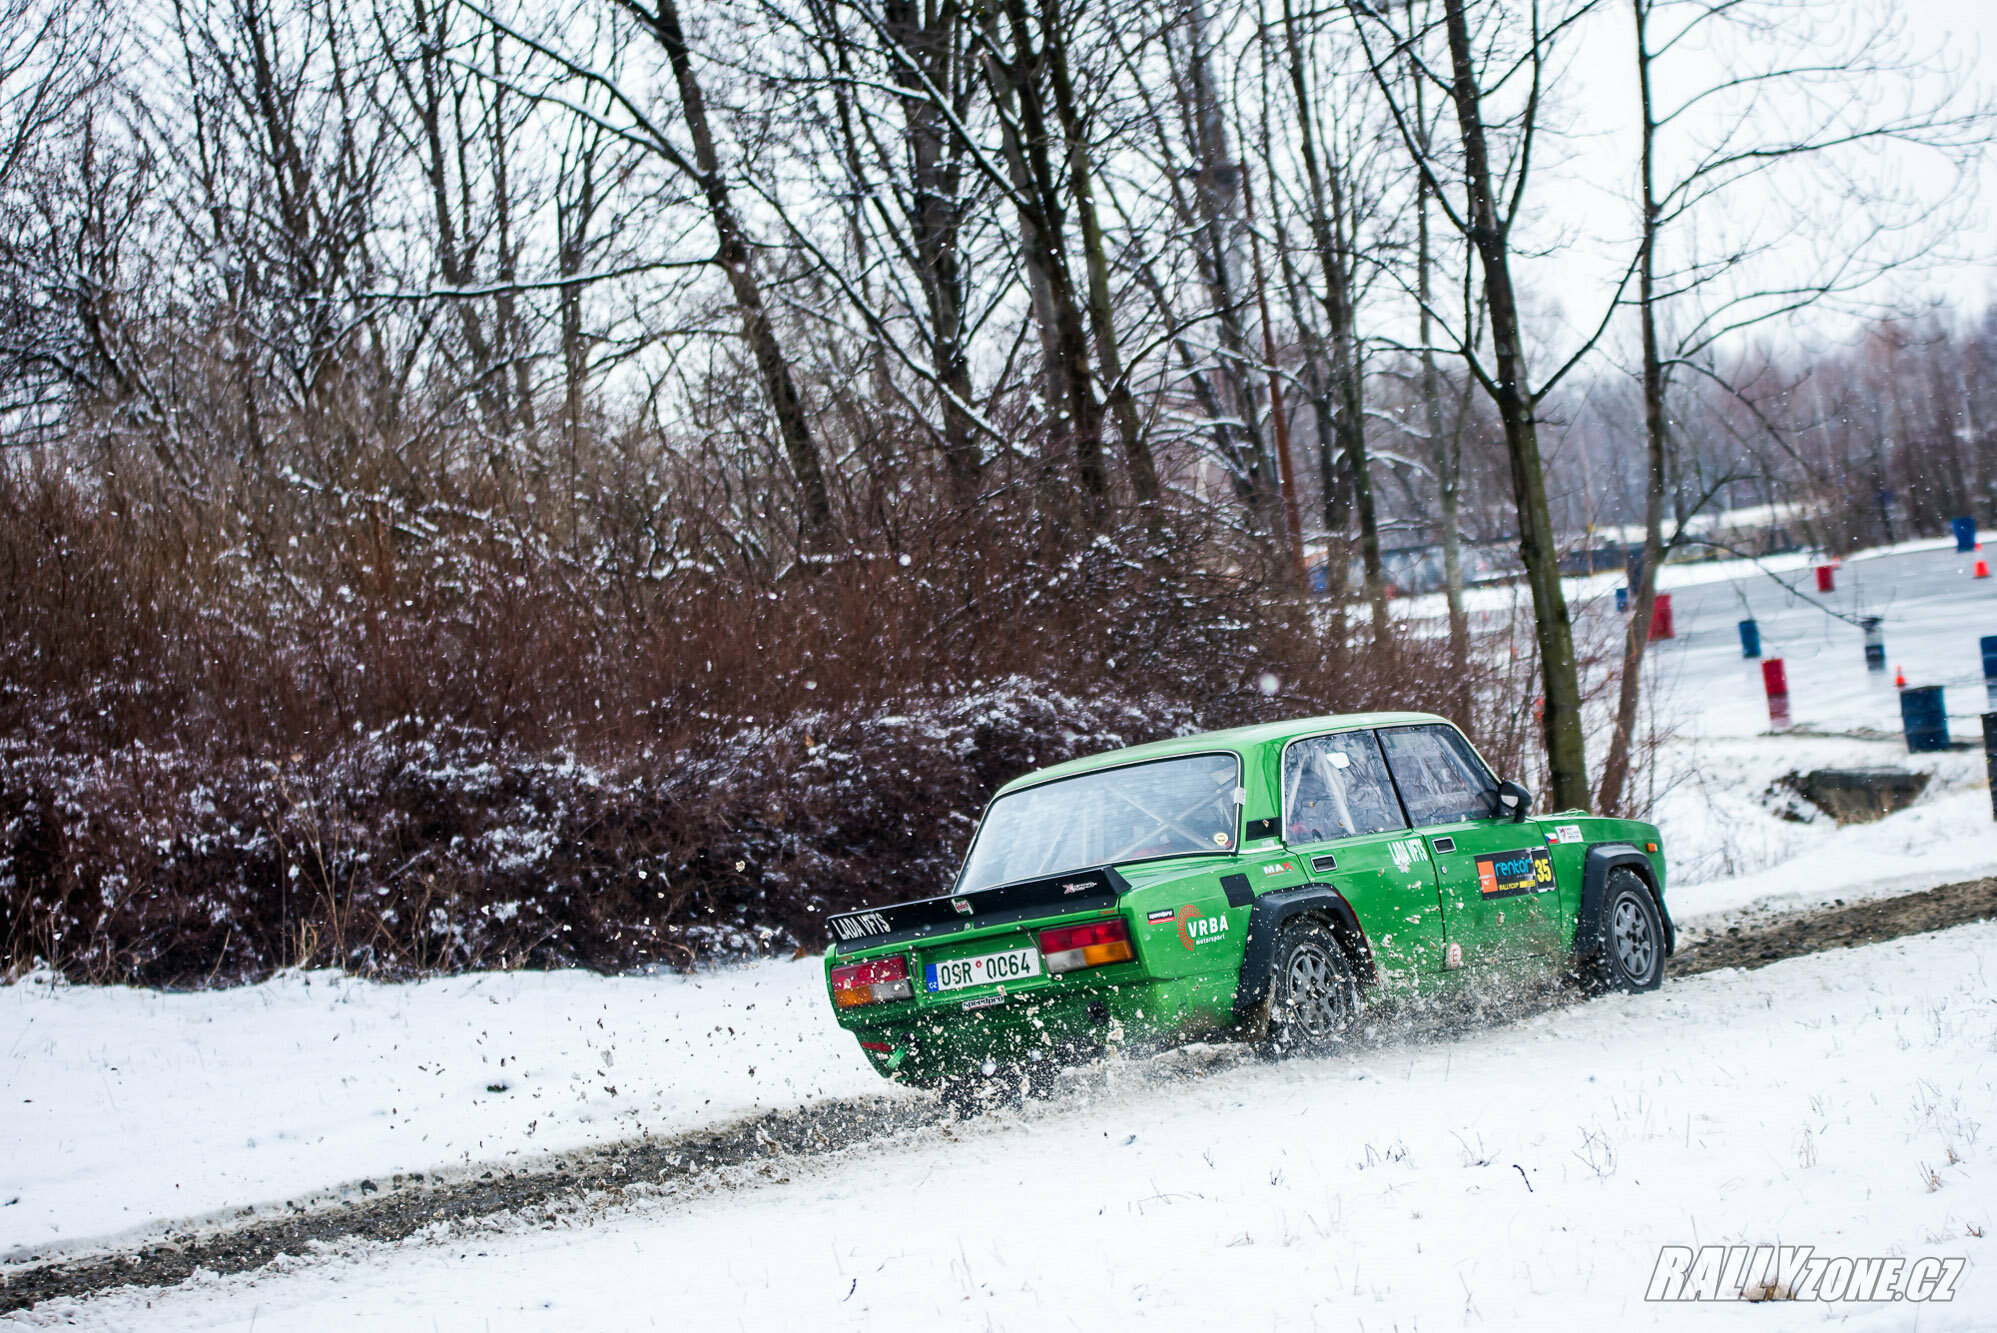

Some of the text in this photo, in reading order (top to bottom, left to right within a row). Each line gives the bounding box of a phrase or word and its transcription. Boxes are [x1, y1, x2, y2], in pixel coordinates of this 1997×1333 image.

[1387, 838, 1428, 866] LADA VFTS
[1495, 858, 1531, 877] rentor
[1534, 858, 1552, 883] 35
[831, 912, 891, 940] LADA VFTS
[1187, 915, 1229, 938] VRBA
[1195, 933, 1225, 946] motorsport
[928, 981, 938, 989] CZ
[941, 962, 973, 986] OSR
